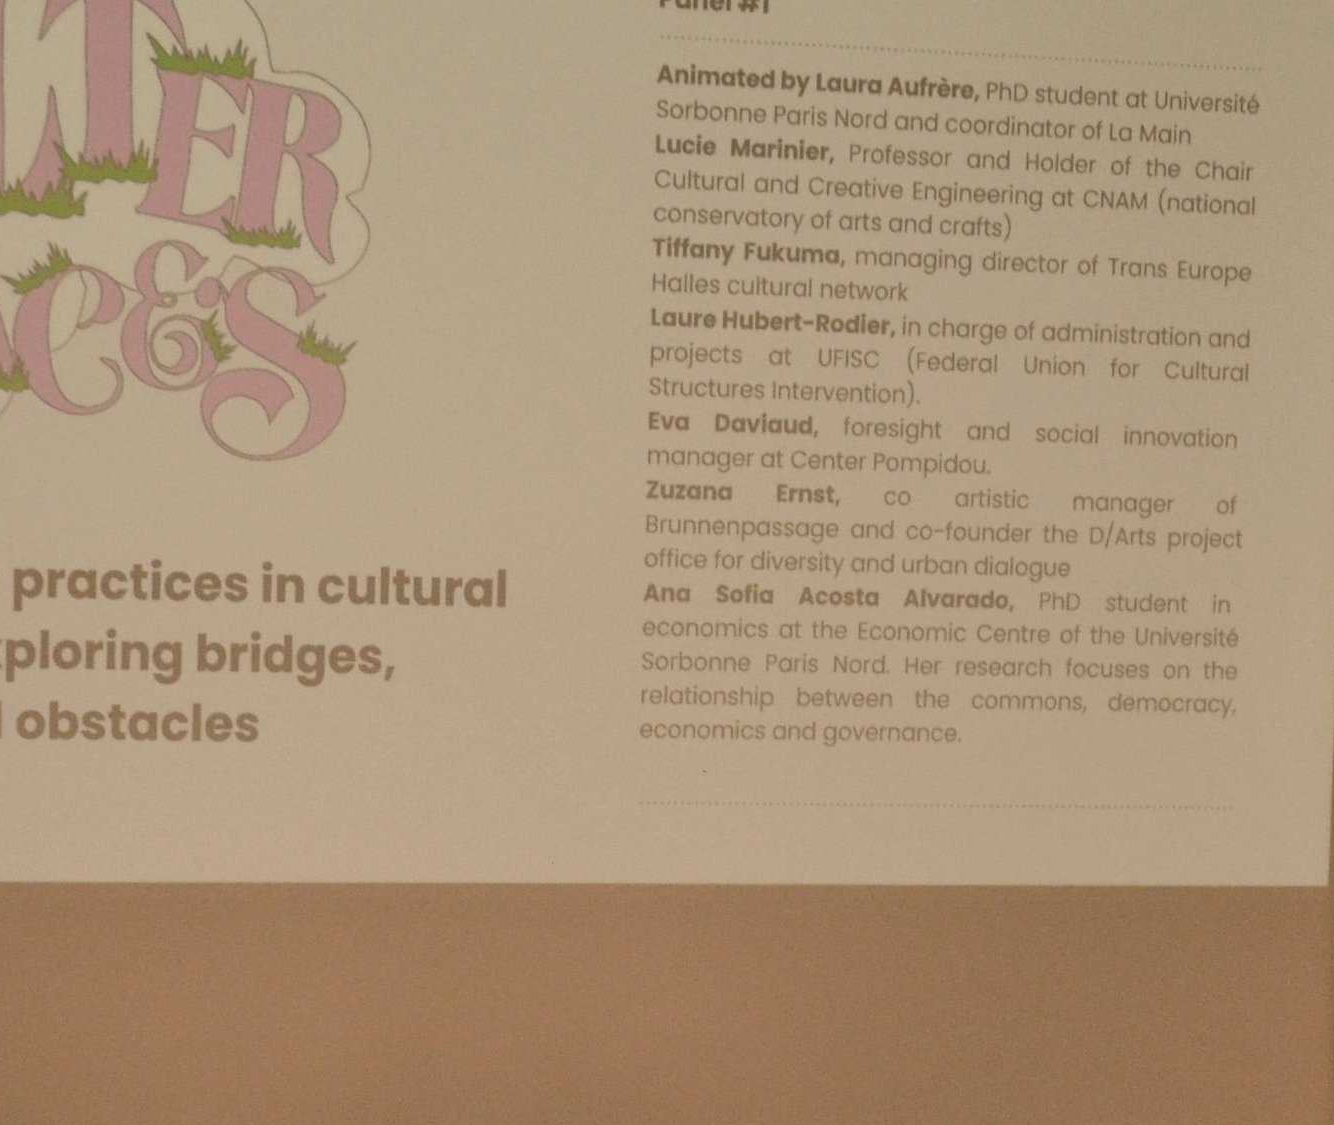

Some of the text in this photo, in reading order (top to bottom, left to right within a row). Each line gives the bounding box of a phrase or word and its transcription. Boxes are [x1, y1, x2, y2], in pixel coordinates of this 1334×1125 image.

[656, 63, 1261, 116] Animated by Laura Aufrère, PhD student at Université
[656, 98, 1192, 145] Sorbonne Paris Nord and coordinator of La Main
[654, 133, 1254, 182] Lucie Marinier, Professor and Holder of the Chair
[653, 168, 1257, 217] Cultural and Creative Engineering at CNAM (national
[652, 206, 1012, 243] conservatory of arts and crafts)
[651, 236, 1253, 288] Tiffany Fukuma, managing director of Trans Europe
[651, 272, 909, 302] Halles cultural network
[650, 306, 1251, 350] Laure Hubert-Rodier, in charge of administration and
[649, 341, 1250, 382] projects at UFISC (Federal Union for Cultural
[649, 376, 920, 409] Structures Intervention).
[647, 410, 1238, 449] Eva Daviaud, foresight and social innovation
[647, 448, 991, 479] manager at Center Pompidou.
[645, 479, 1237, 520] Zuzana Ernst, co artistic manager of
[645, 514, 1243, 554] Brunnenpassage and co-founder the D/Arts project
[643, 547, 1071, 583] office for diversity and urban dialogue
[12, 559, 248, 612] practices
[262, 561, 305, 604] in
[317, 566, 507, 608] cultural
[642, 582, 1231, 614] Ana Sofia Acosta Alvarado, PhD student in
[642, 617, 1239, 648] economics at the Economic Centre of the Université
[196, 631, 395, 687] bridges,
[641, 651, 1238, 681] Sorbonne Paris Nord. Her research focuses on the
[16, 700, 259, 742] obstacles
[640, 684, 1236, 720] relationship between the commons, democracy,
[639, 719, 962, 747] economics and governance.
